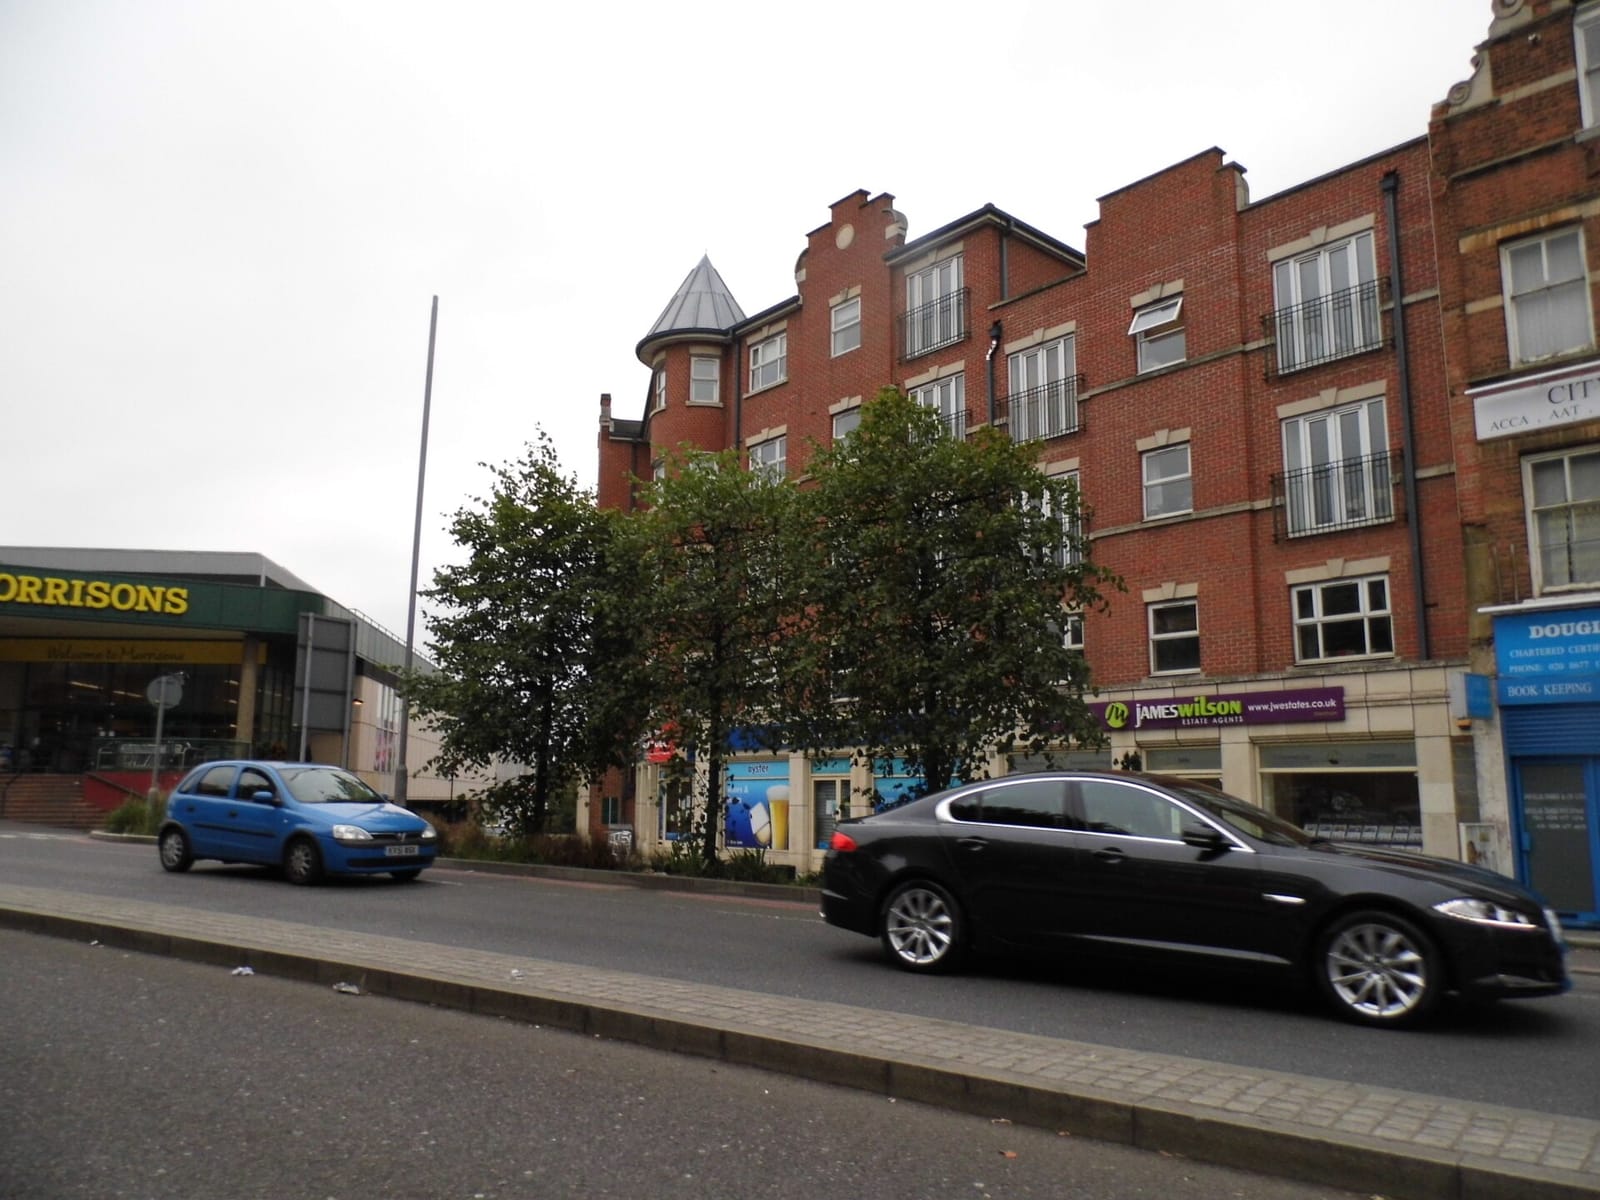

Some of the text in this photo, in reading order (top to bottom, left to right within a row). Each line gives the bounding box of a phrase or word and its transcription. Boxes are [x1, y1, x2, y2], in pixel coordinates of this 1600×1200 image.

[1548, 377, 1600, 405] CIT
[1490, 405, 1579, 432] ACCA AAT
[1247, 699, 1337, 713] www.jwestates.co.uk
[1182, 715, 1244, 726] ESTATE AGENTS
